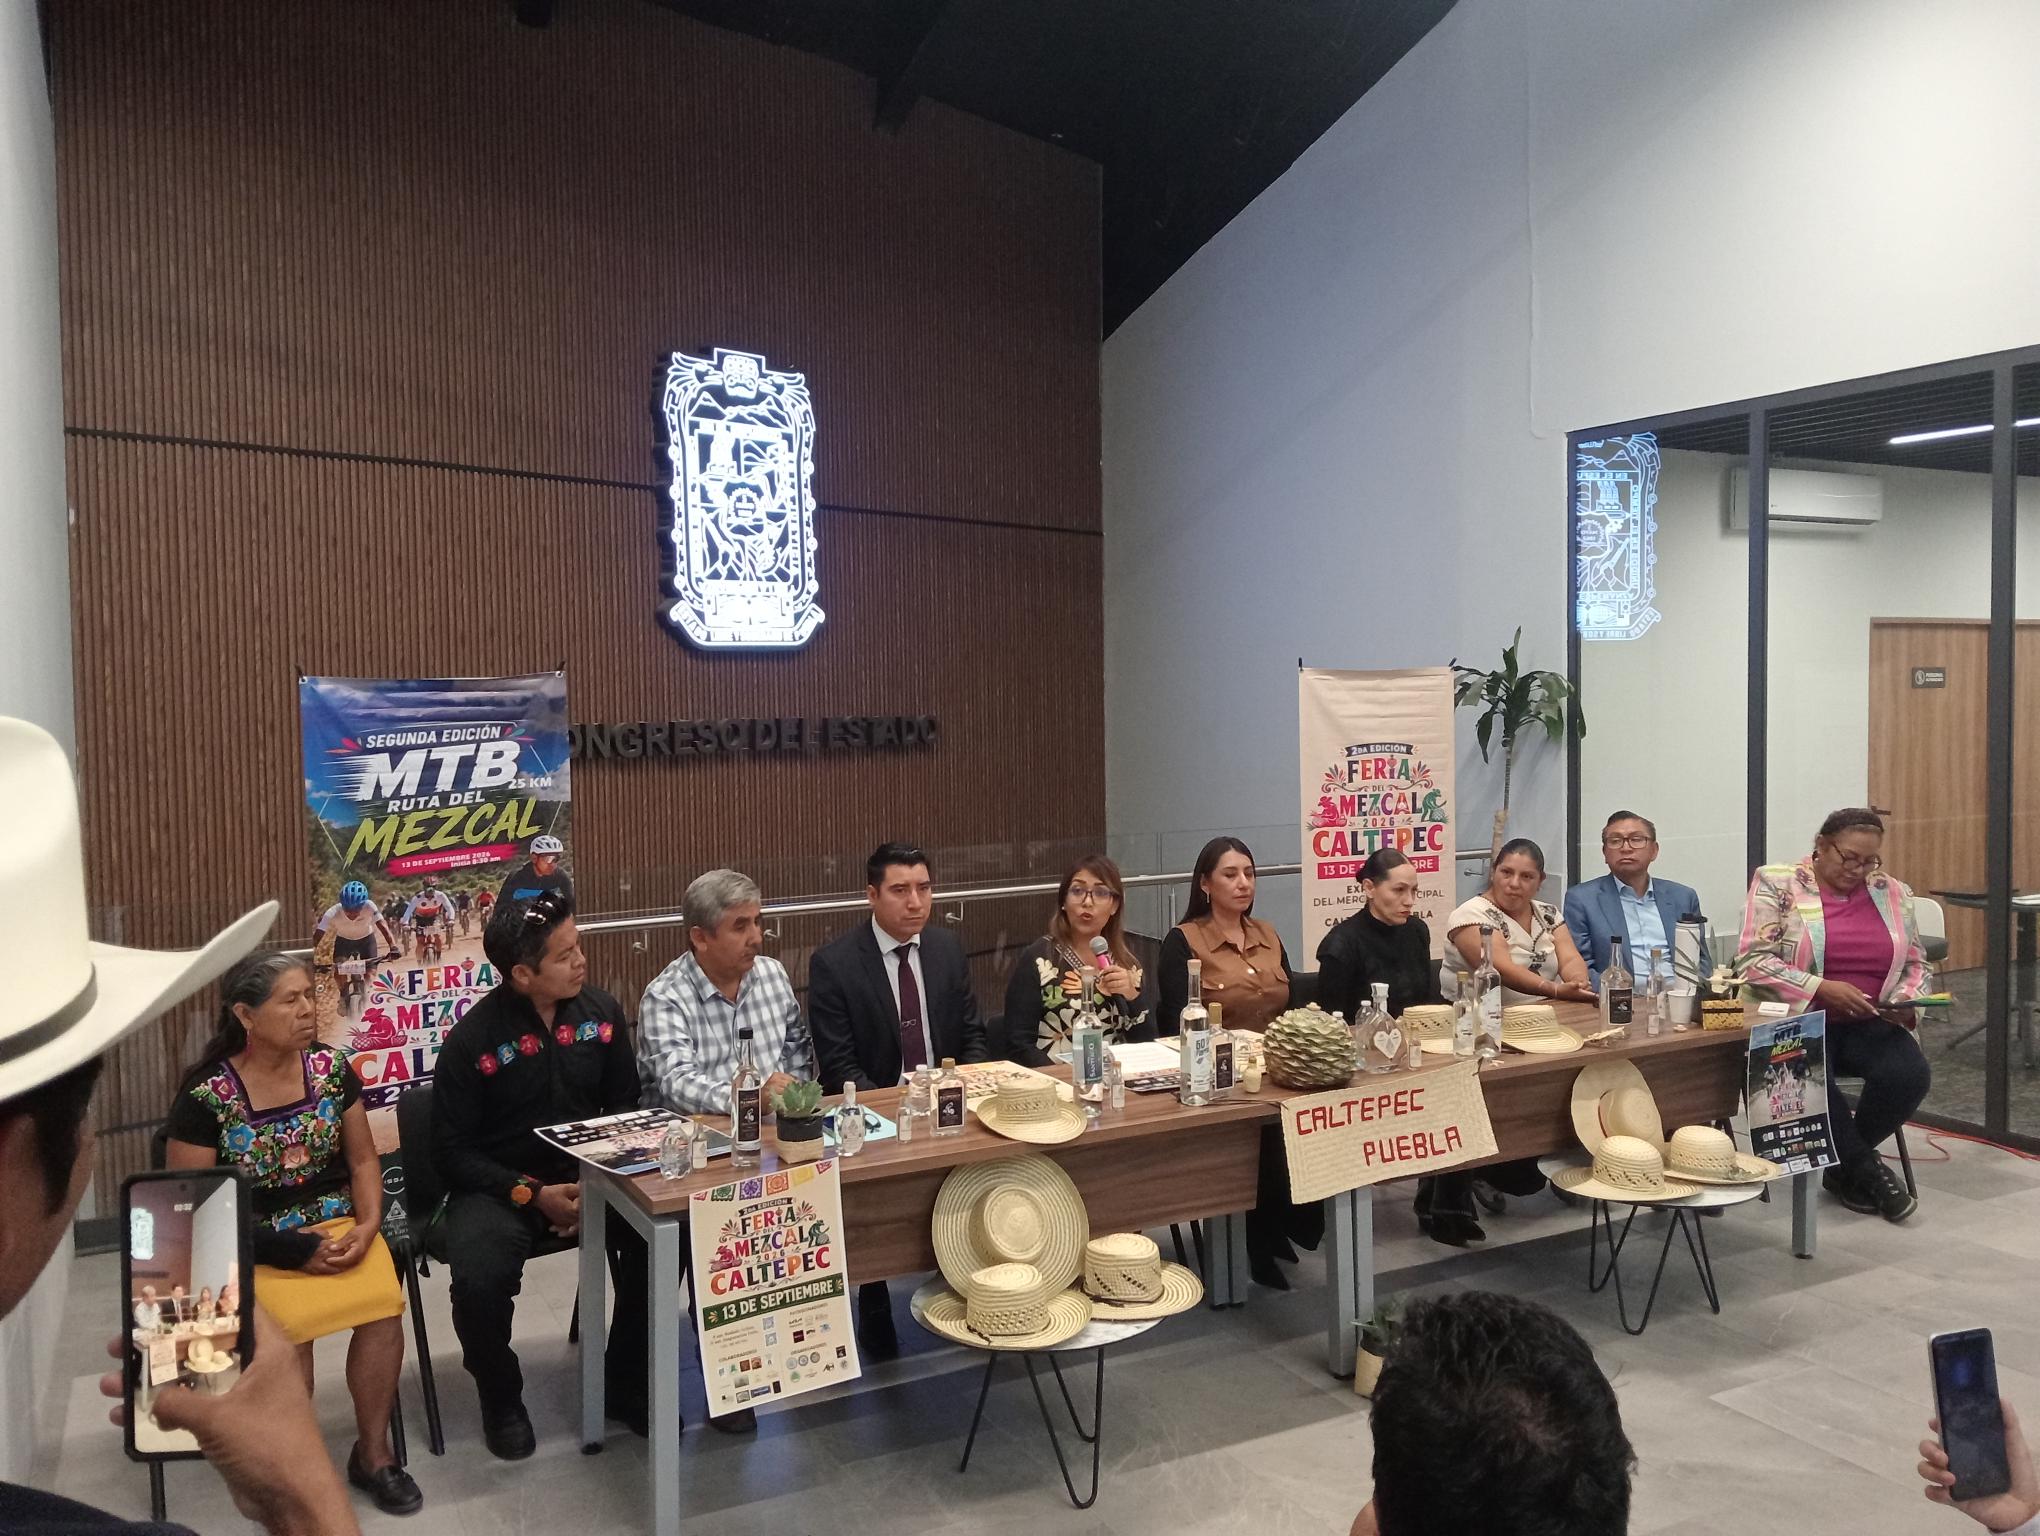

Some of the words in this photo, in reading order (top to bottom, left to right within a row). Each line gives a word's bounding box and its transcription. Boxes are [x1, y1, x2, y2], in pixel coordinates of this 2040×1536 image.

[366, 731, 437, 748] SEGUNDA
[442, 724, 501, 742] EDICIÓN
[568, 719, 749, 760] ONGRESO
[755, 717, 820, 750] DEL
[828, 715, 938, 746] ESTADO
[354, 740, 521, 801] MTB
[508, 778, 526, 790] 25
[529, 776, 552, 788] KM
[386, 797, 440, 813] RUTA
[448, 791, 486, 806] DEL
[1339, 791, 1423, 817] MEZCAL
[342, 797, 543, 871] MEZCAL
[1363, 817, 1395, 827] 2026
[1312, 824, 1444, 858] CALTEPEC
[1323, 865, 1335, 875] 13
[1340, 864, 1356, 875] DE
[1313, 897, 1333, 907] DEL
[1336, 894, 1367, 905] MERC
[1416, 889, 1445, 899] CIPAL
[442, 989, 460, 998] DEL
[396, 998, 471, 1031] MEZC
[1296, 1088, 1424, 1135] CALTEPEC
[1363, 1126, 1462, 1166] PUEBLA
[735, 1226, 809, 1257] MEZCAL
[756, 1249, 785, 1263] 2026
[710, 1246, 831, 1295] CALTEPEC
[722, 1306, 737, 1320] 13
[740, 1301, 758, 1314] DE
[760, 1279, 834, 1310] SEPTIEMBRE
